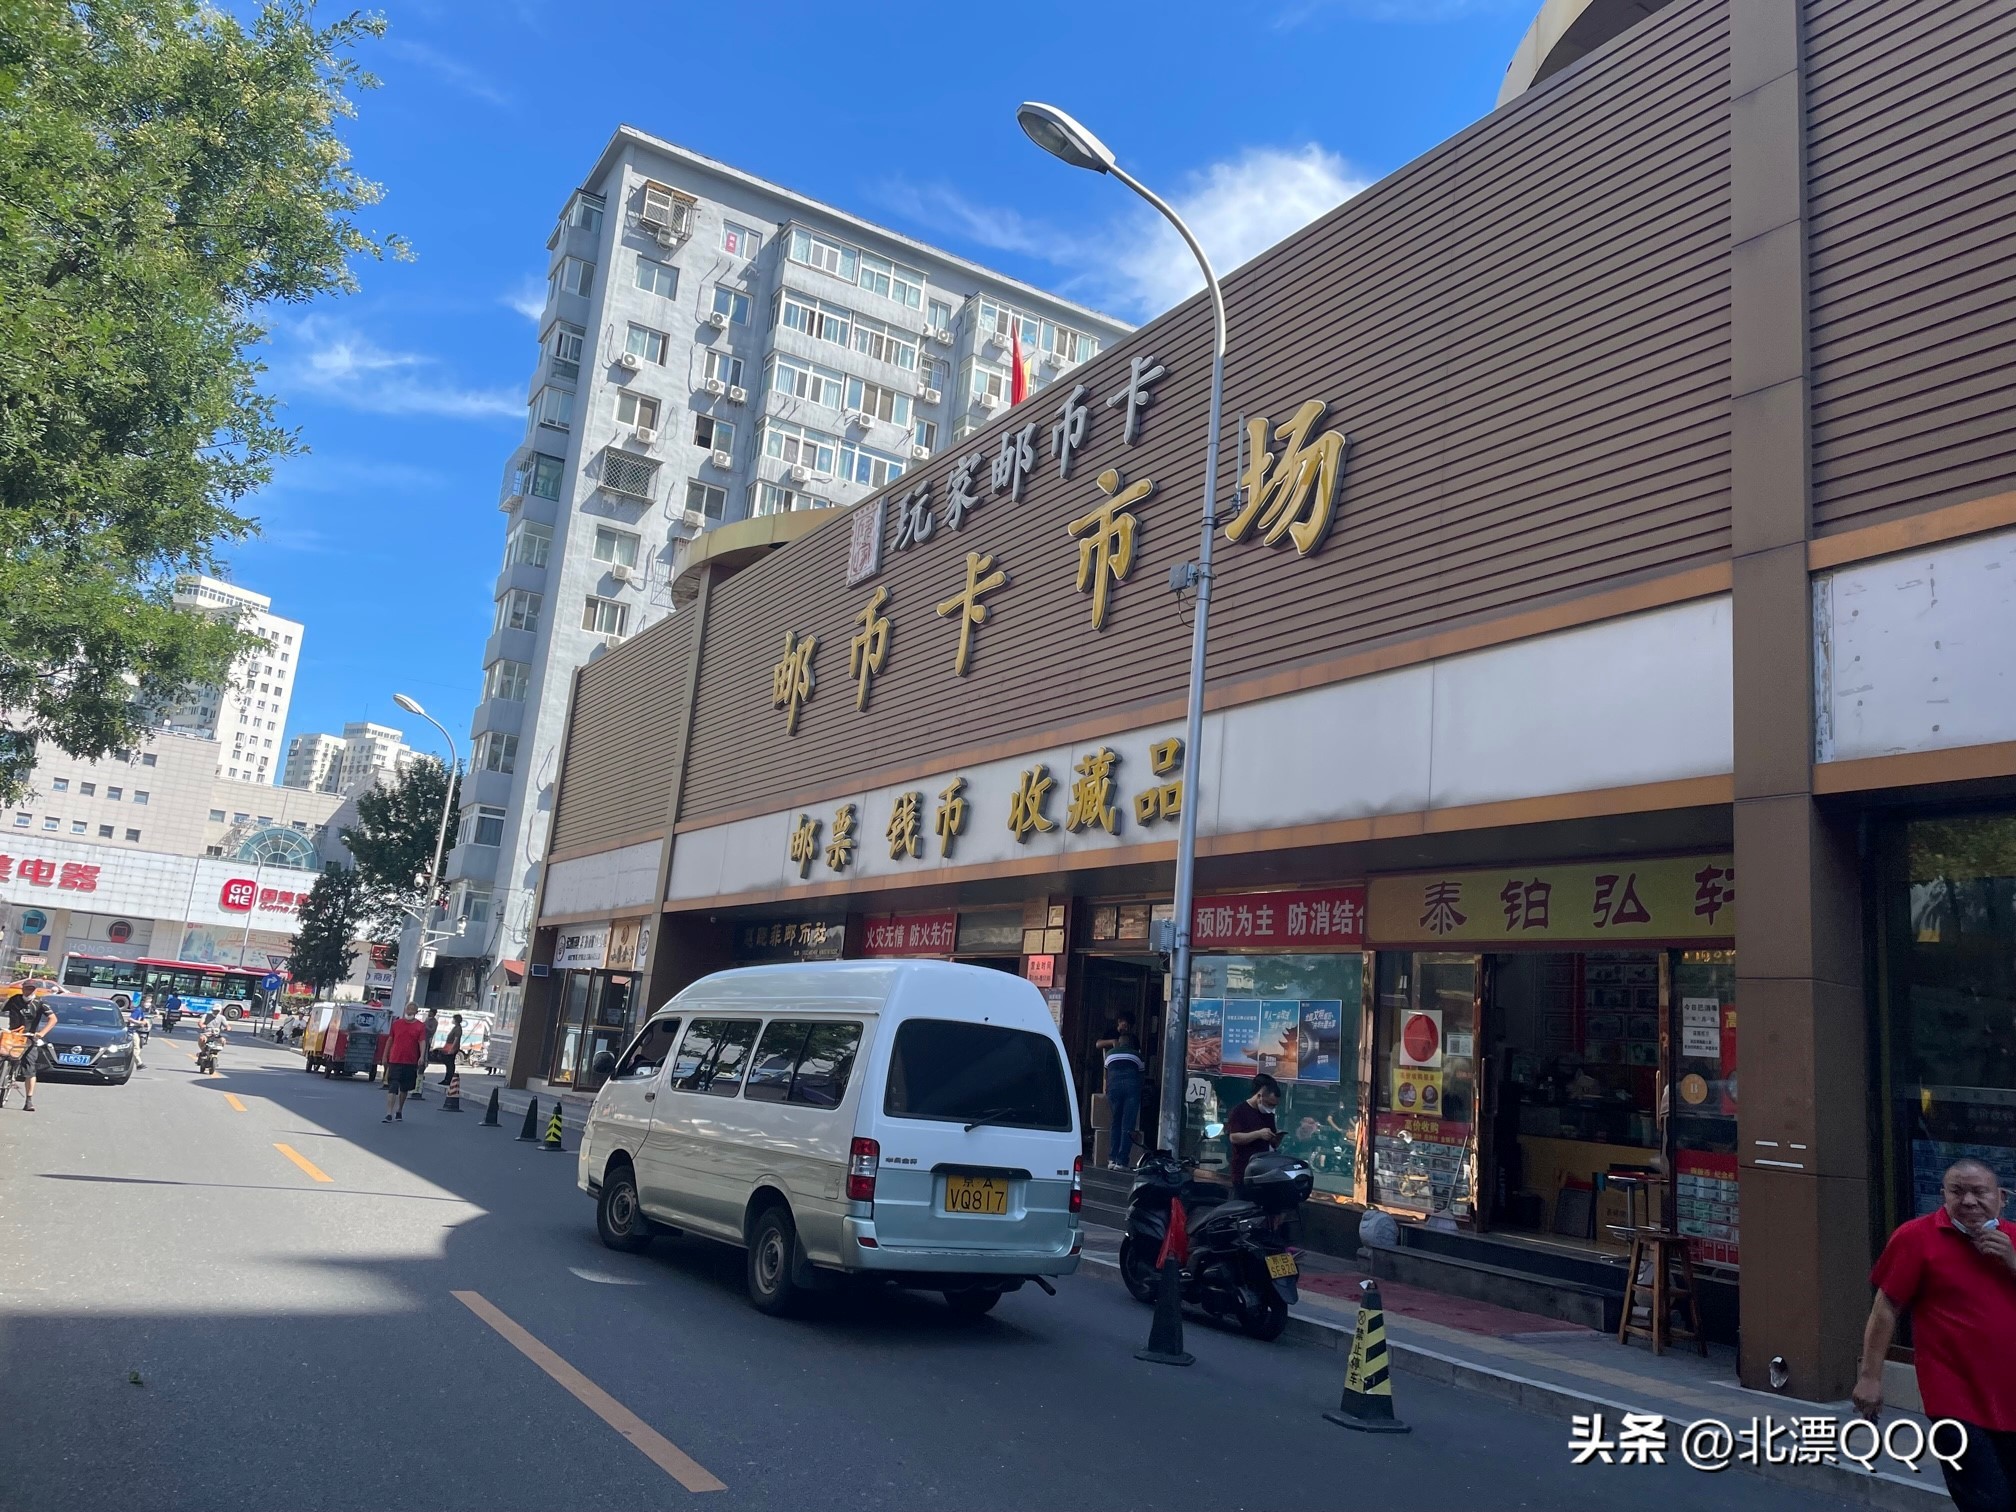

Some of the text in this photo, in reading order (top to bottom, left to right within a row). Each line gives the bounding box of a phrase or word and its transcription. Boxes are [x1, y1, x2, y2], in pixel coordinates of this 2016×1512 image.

[890, 356, 1165, 551] 玩家邮币卡
[773, 400, 1351, 736] 邮币卡市场
[790, 738, 1184, 879] 邮票 钱币 收藏品
[228, 893, 251, 905] ME
[230, 884, 253, 895] GO
[865, 921, 953, 948] 火灾无情 防火先行
[1196, 904, 1274, 938] 预防为主
[1190, 1083, 1207, 1096] 入口
[1404, 1119, 1439, 1133] 高价收购
[950, 1189, 1005, 1211] VQ817
[1349, 1327, 1365, 1386] 禁止停车
